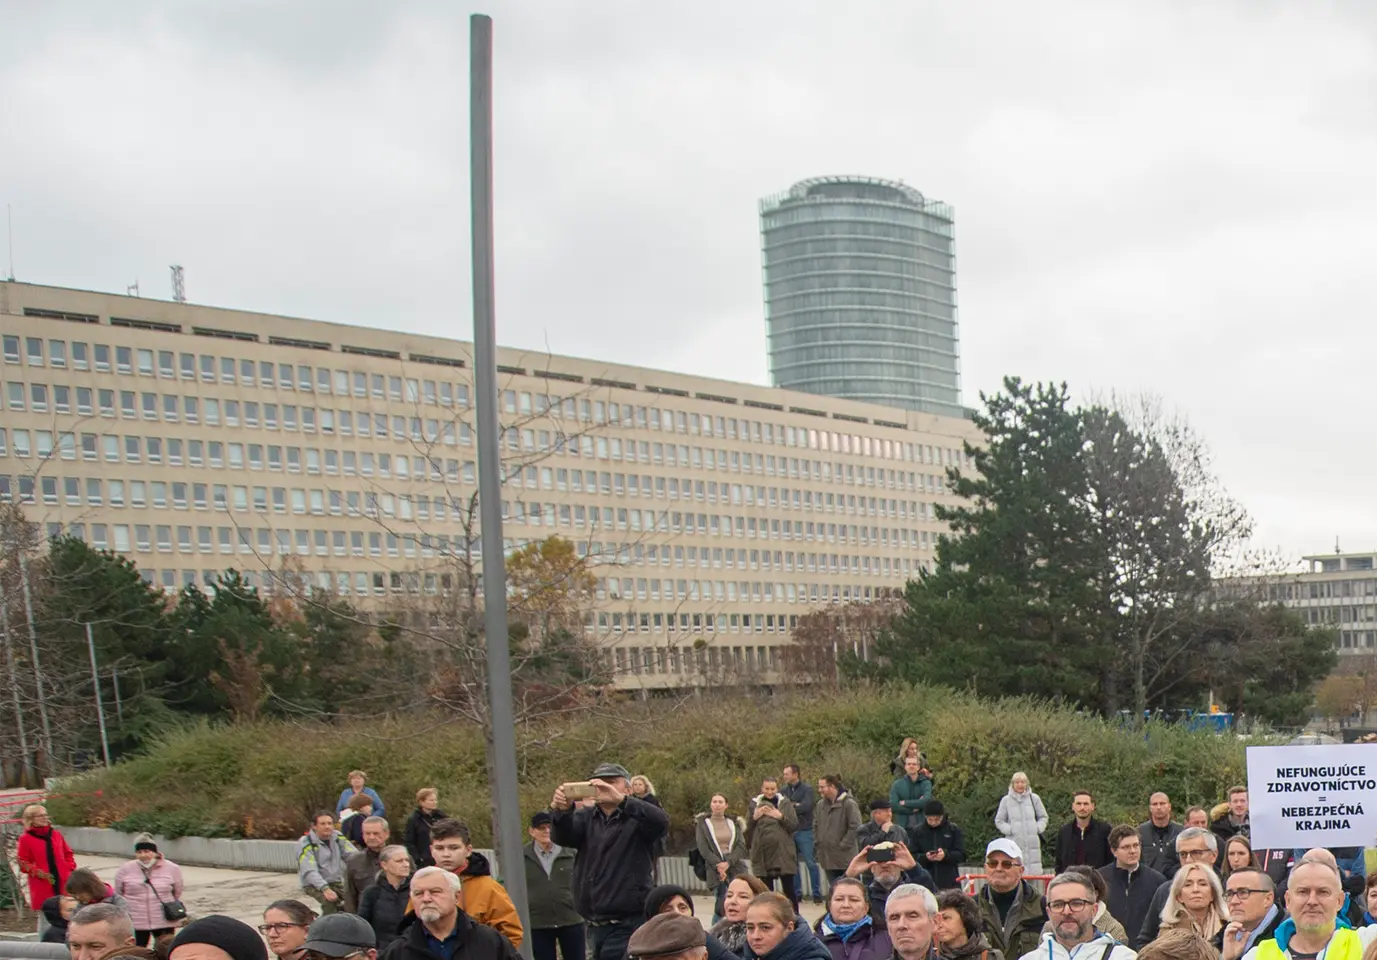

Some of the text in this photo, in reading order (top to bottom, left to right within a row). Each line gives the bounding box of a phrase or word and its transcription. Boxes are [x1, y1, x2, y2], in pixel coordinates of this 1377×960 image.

[1276, 764, 1366, 778] NEFUNGUJÚCE
[1267, 779, 1376, 793] ZDRAVOTNÍCTVO
[1281, 803, 1364, 817] NEBEZPEČNÁ
[1295, 819, 1351, 831] KRAJINA
